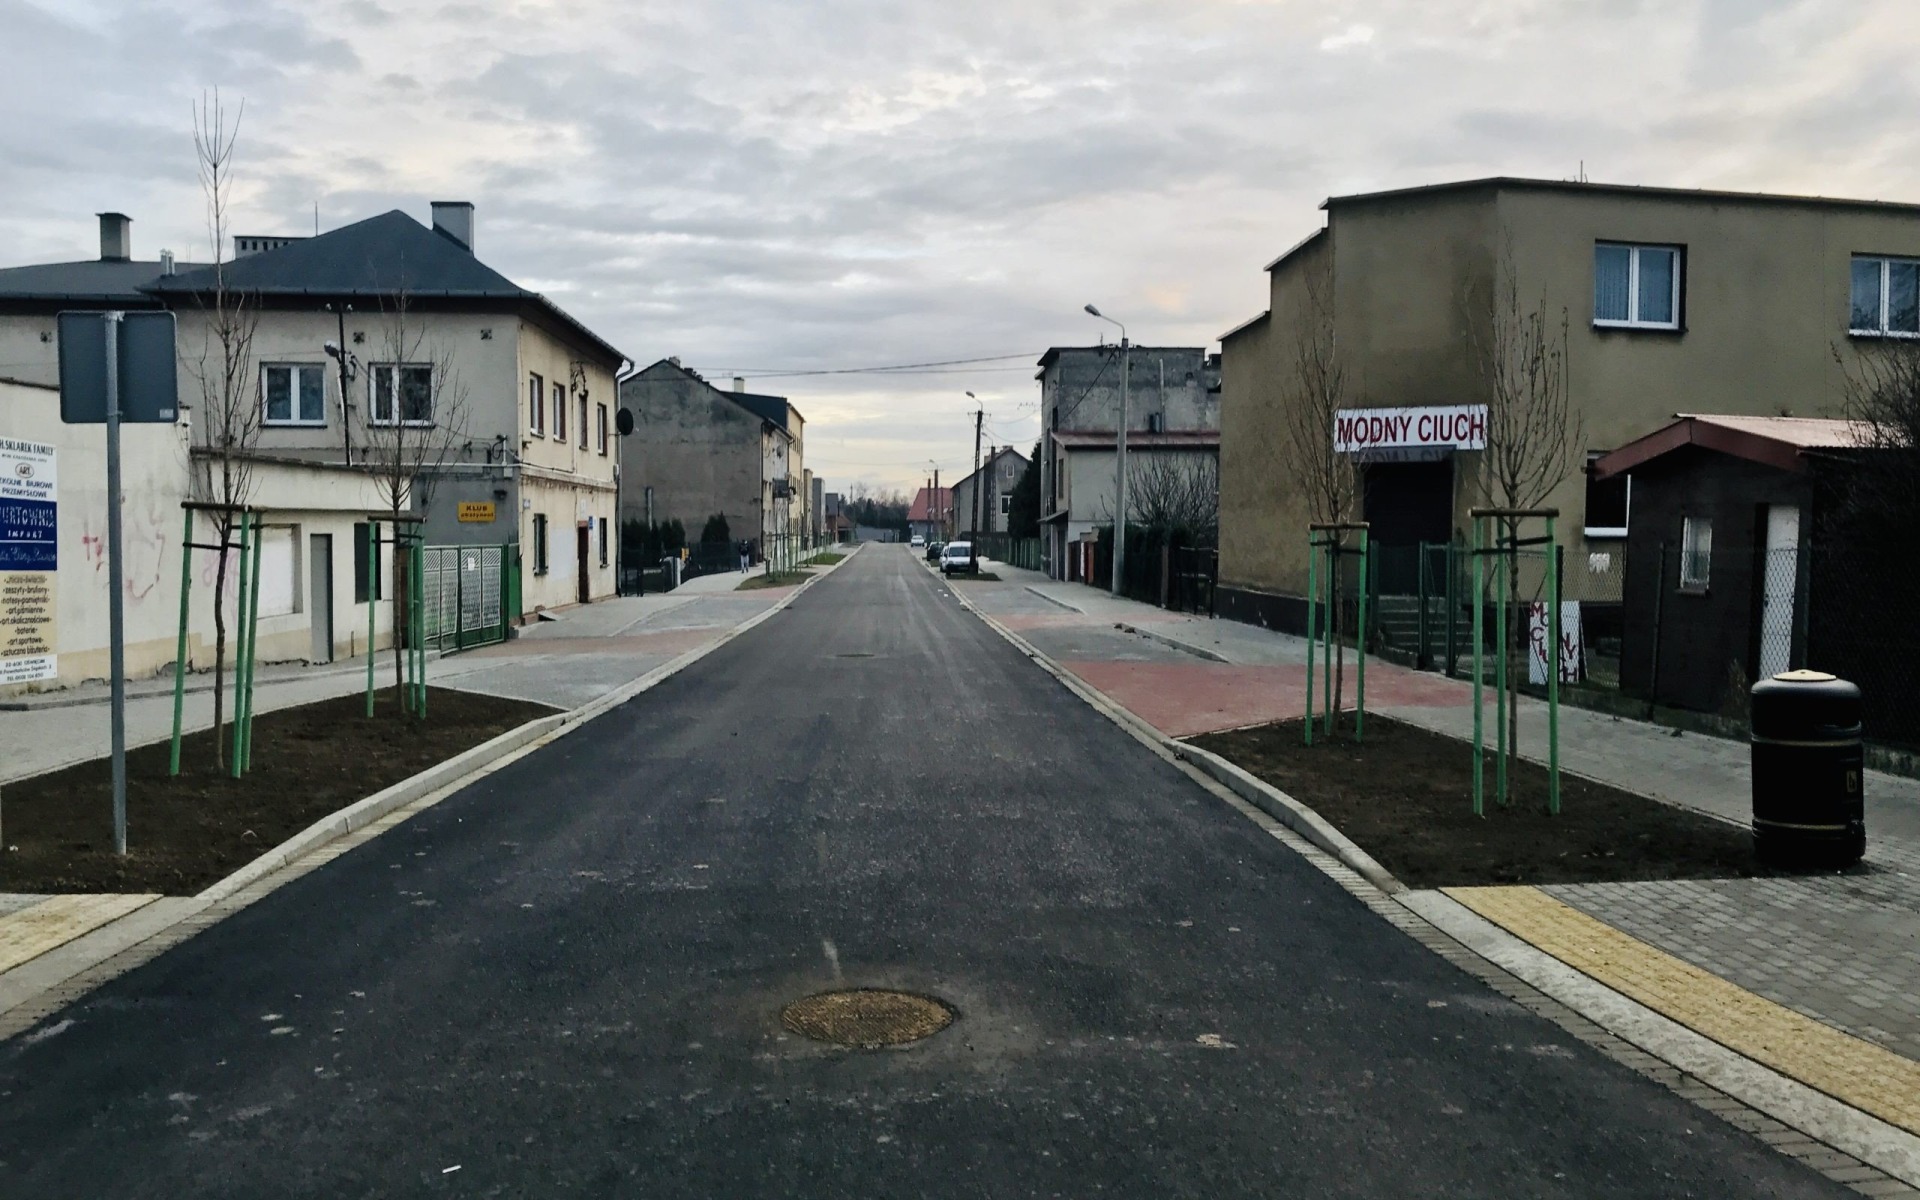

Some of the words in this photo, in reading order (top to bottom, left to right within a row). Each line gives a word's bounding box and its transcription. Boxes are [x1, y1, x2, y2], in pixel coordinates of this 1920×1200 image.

[1337, 416, 1412, 444] MODNY
[1418, 413, 1484, 442] CIUCH
[0, 506, 55, 528] URTOWNIA
